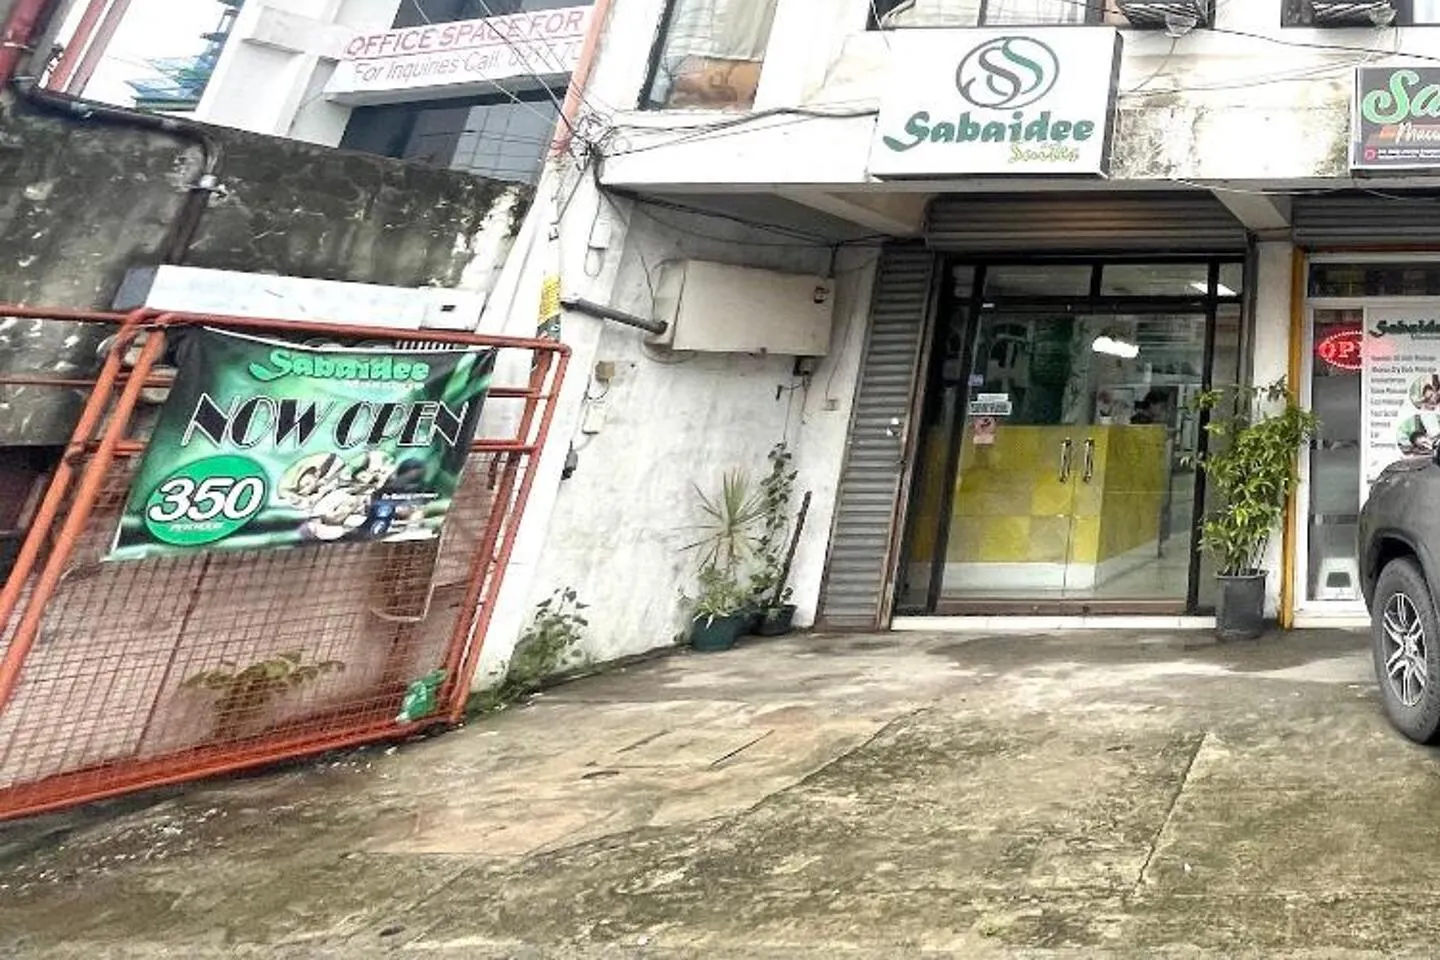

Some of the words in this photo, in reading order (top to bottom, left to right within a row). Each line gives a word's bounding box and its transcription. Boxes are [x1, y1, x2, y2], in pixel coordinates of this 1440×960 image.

[346, 29, 433, 56] OFFICE
[439, 19, 521, 46] SPACE
[529, 10, 585, 35] FOR
[355, 60, 385, 82] For
[883, 110, 1096, 152] Sabaidee
[249, 348, 431, 382] Sabaidee
[181, 392, 334, 449] NOW
[333, 399, 470, 450] OPEN
[148, 475, 266, 522] 350
